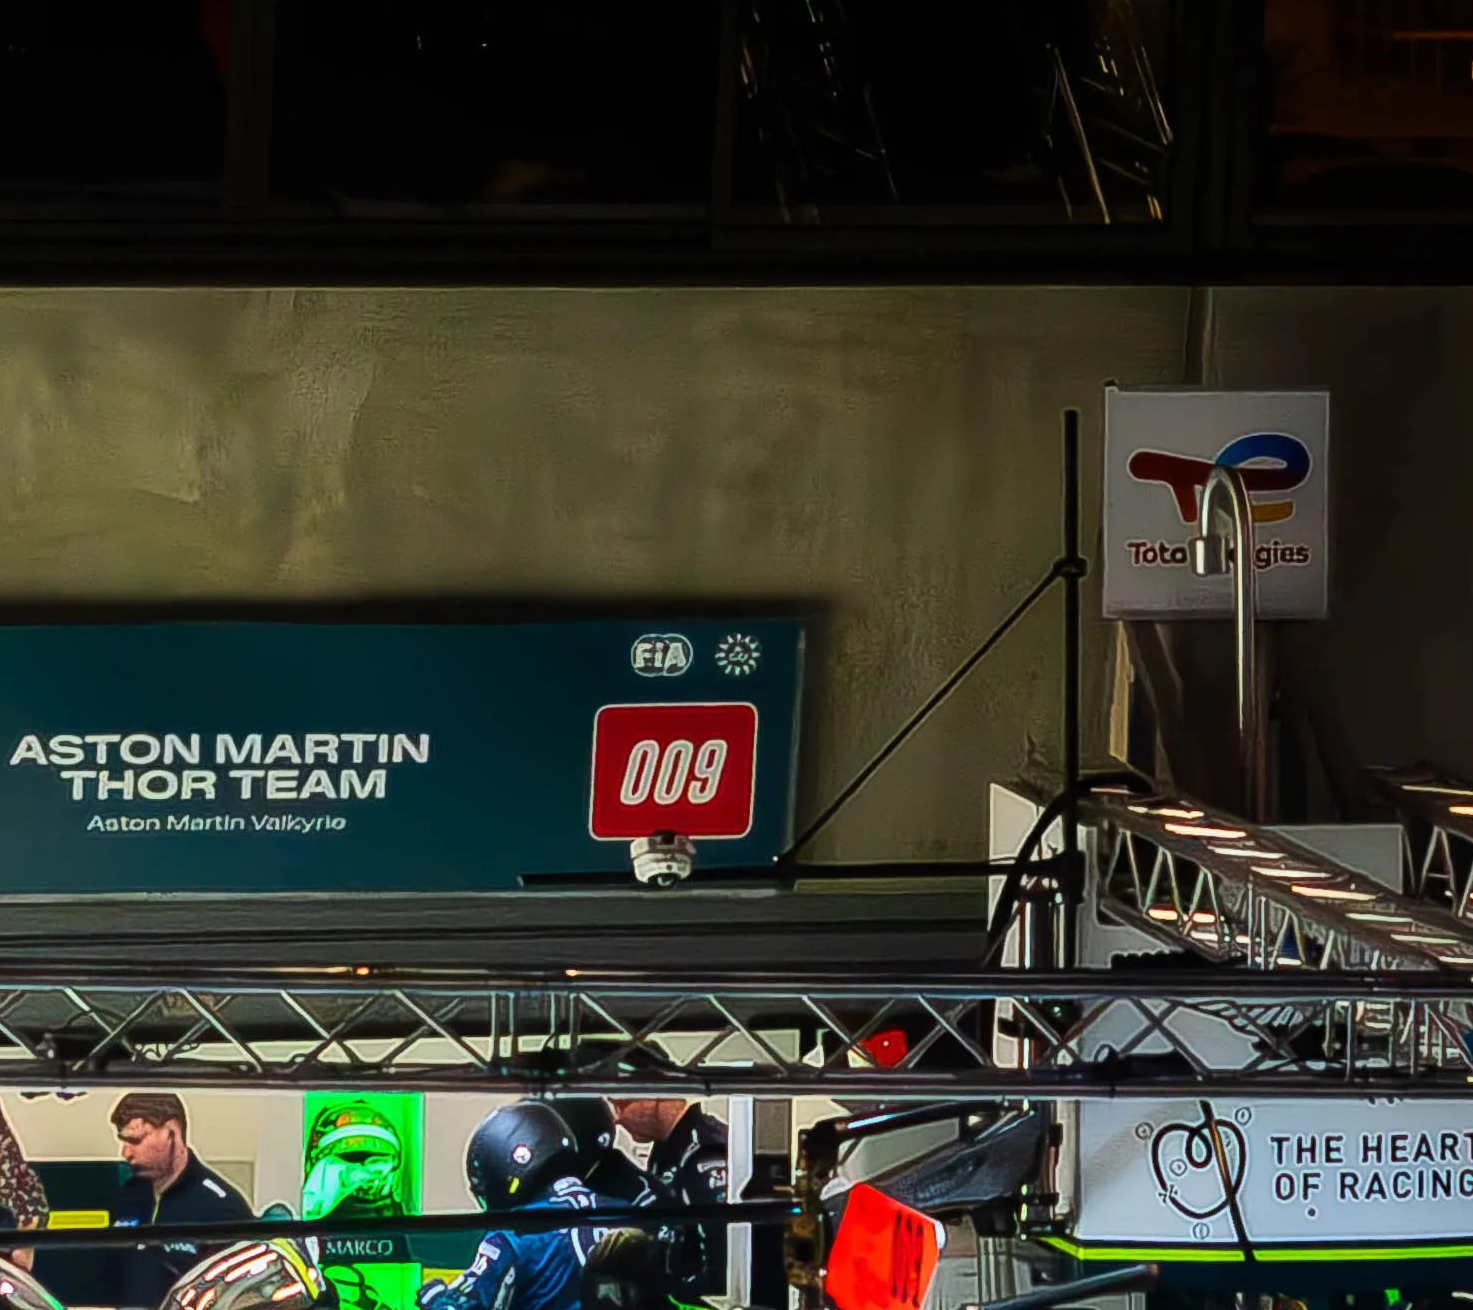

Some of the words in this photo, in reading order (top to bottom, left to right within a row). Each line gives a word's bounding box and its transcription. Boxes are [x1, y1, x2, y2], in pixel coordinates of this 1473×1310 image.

[635, 641, 687, 670] FIA
[10, 734, 199, 765] ASTON
[216, 734, 429, 765] MARTIN
[61, 770, 216, 801] THOR
[229, 770, 386, 801] TEAM
[620, 739, 728, 805] 009
[87, 815, 160, 833] Aston
[167, 815, 244, 833] Martin
[1271, 1132, 1343, 1165] THE
[1275, 1170, 1321, 1201] OF
